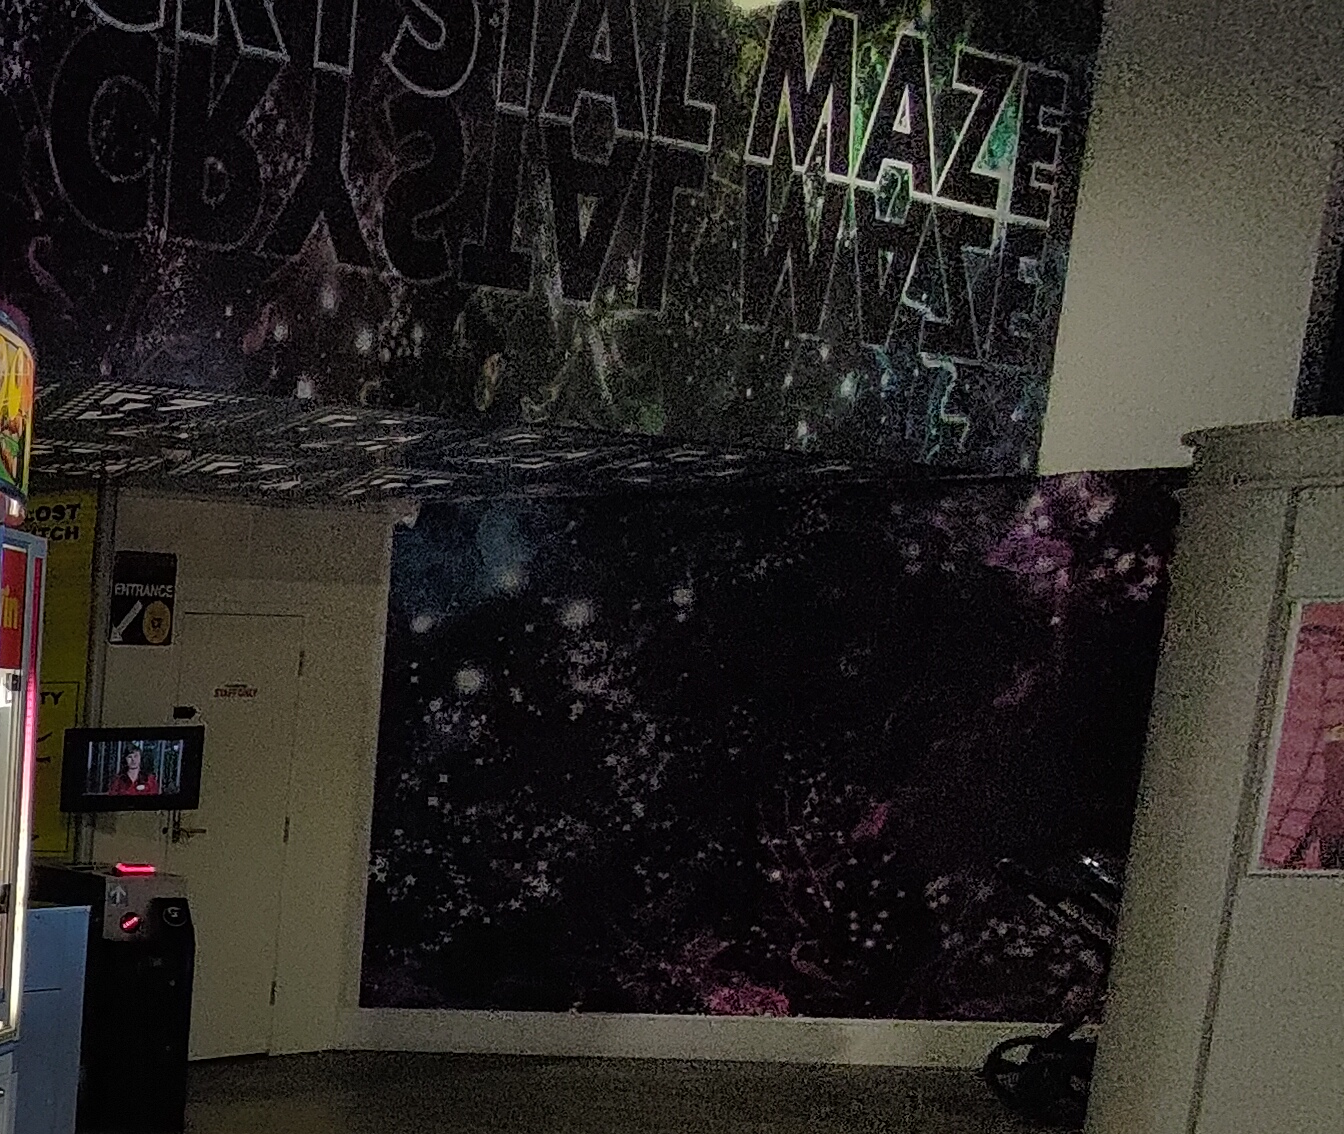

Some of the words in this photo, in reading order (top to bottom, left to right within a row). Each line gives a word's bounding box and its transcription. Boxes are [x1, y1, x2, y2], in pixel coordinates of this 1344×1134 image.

[744, 0, 1070, 228] MAZE
[115, 583, 174, 599] ENTRANCE
[39, 691, 63, 705] TY
